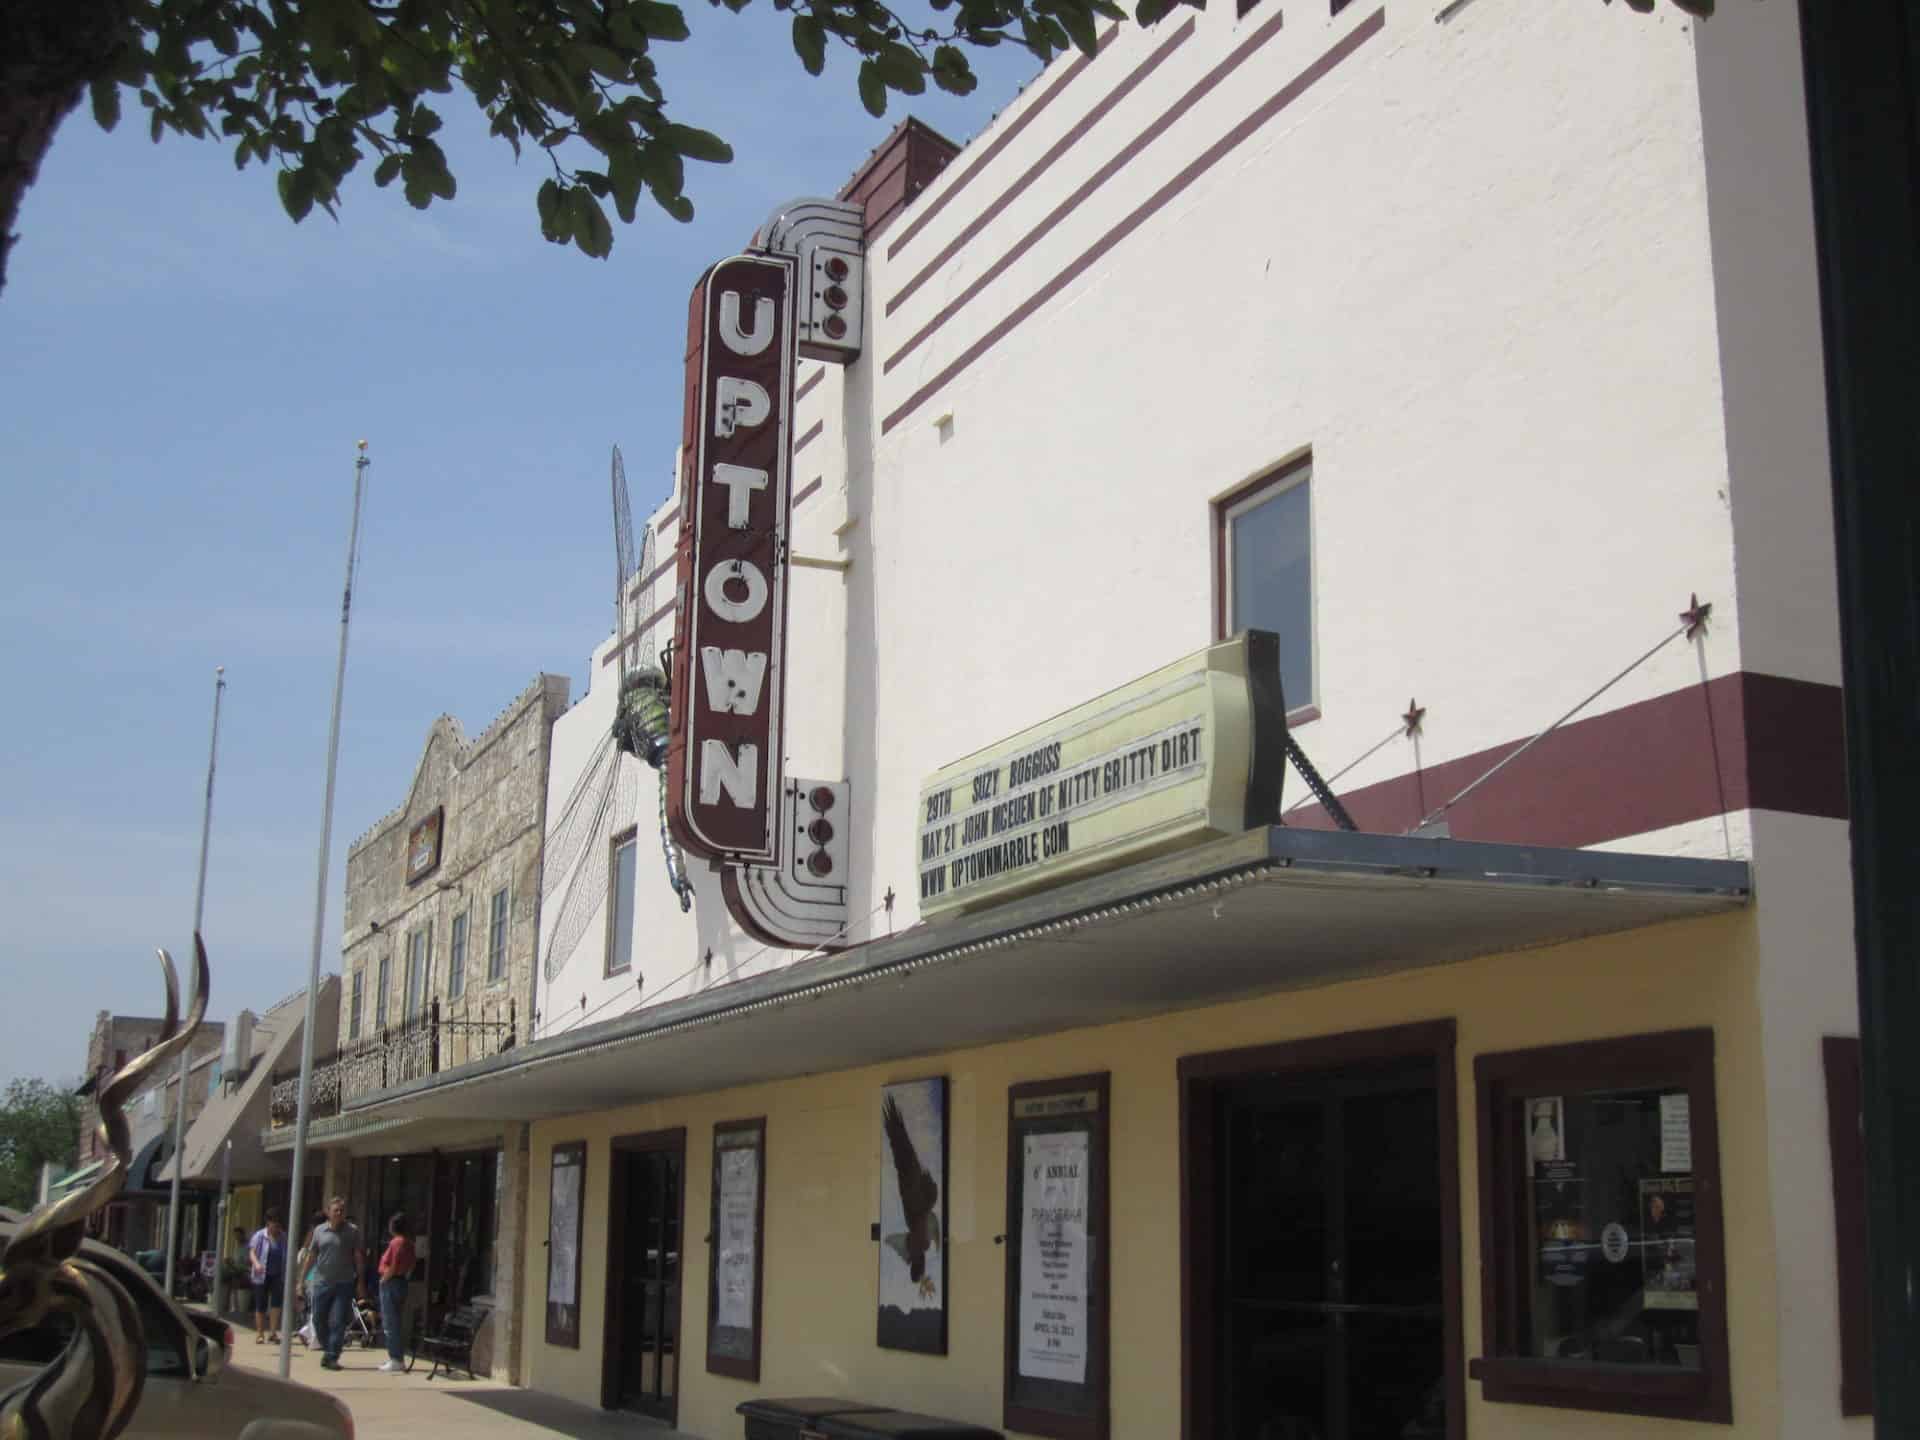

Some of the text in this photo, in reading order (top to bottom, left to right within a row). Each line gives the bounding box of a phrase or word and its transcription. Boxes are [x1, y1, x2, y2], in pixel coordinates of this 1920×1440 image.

[699, 290, 775, 809] UPTOWN
[922, 728, 1203, 860] MAY 21 JOHN MCEUEN OF NITTY GRITTY DIRT
[927, 741, 1061, 823] 29TH SUZY BOGGUSS
[921, 821, 1069, 898] WWW UPTOWNMARBLE COM
